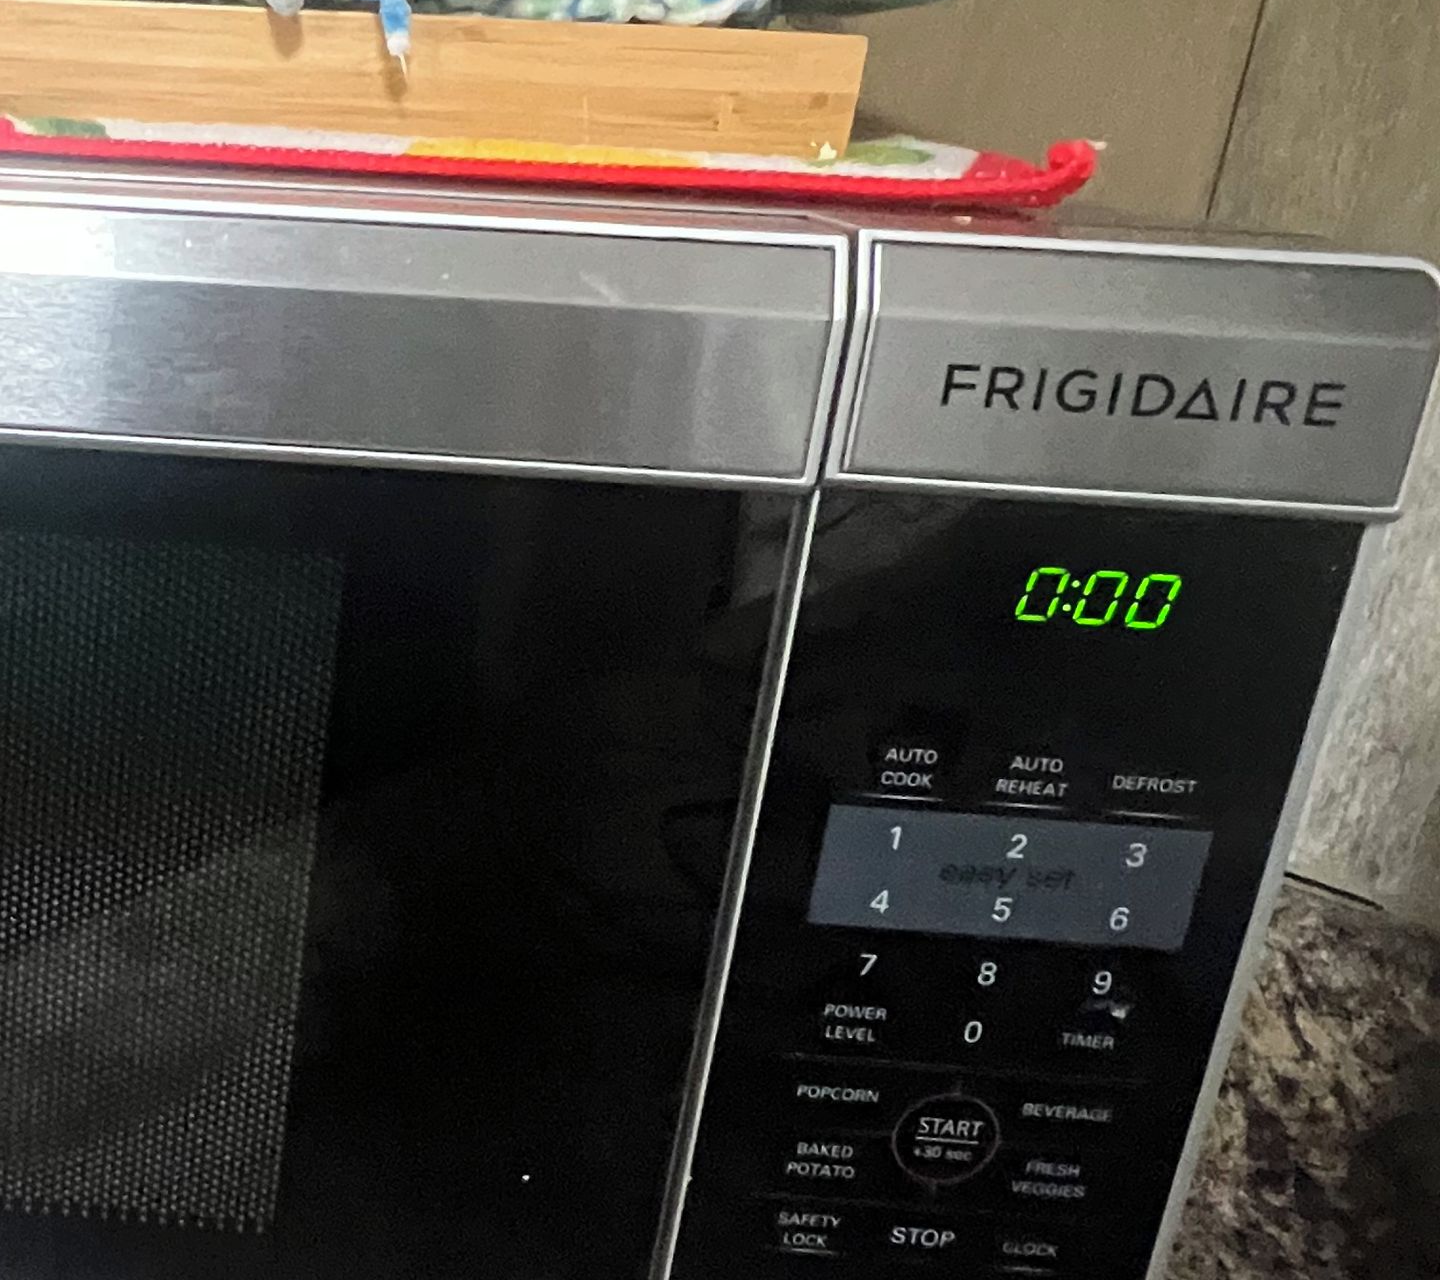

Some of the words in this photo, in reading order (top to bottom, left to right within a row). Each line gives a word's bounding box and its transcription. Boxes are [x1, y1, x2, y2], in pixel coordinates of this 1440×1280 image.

[940, 364, 1347, 428] FRIGIDAIRE
[1014, 566, 1182, 629] 0:00
[884, 747, 938, 766] AUTO
[1010, 755, 1064, 773] AUTO
[880, 770, 933, 789] COOK
[995, 777, 1069, 798] REHEAT
[1112, 774, 1198, 794] DEFROST
[889, 825, 903, 851] 1
[1006, 834, 1028, 859] 2
[1125, 843, 1148, 868] 3
[938, 863, 1018, 891] easy
[869, 890, 890, 915] 4
[992, 897, 1013, 923] 5
[1109, 907, 1130, 931] 6
[860, 953, 878, 976] 7
[977, 962, 997, 986] 8
[1092, 971, 1113, 996] 9
[823, 1004, 888, 1021] POWER
[825, 1025, 877, 1043] LEVEL
[963, 1021, 982, 1044] 0
[1061, 1032, 1115, 1050] TIMER
[796, 1084, 879, 1104] POPCORN
[1022, 1102, 1113, 1123] BEVERAGE
[916, 1117, 984, 1137] START
[796, 1142, 854, 1160] BAKED
[944, 1147, 972, 1162] sec
[786, 1162, 855, 1179] POTATO
[1025, 1160, 1081, 1178] FRESH
[1011, 1180, 1086, 1199] VEGGIES
[783, 1231, 828, 1248] LOCK
[890, 1227, 956, 1248] STOP
[1002, 1241, 1059, 1258] CLOCK
